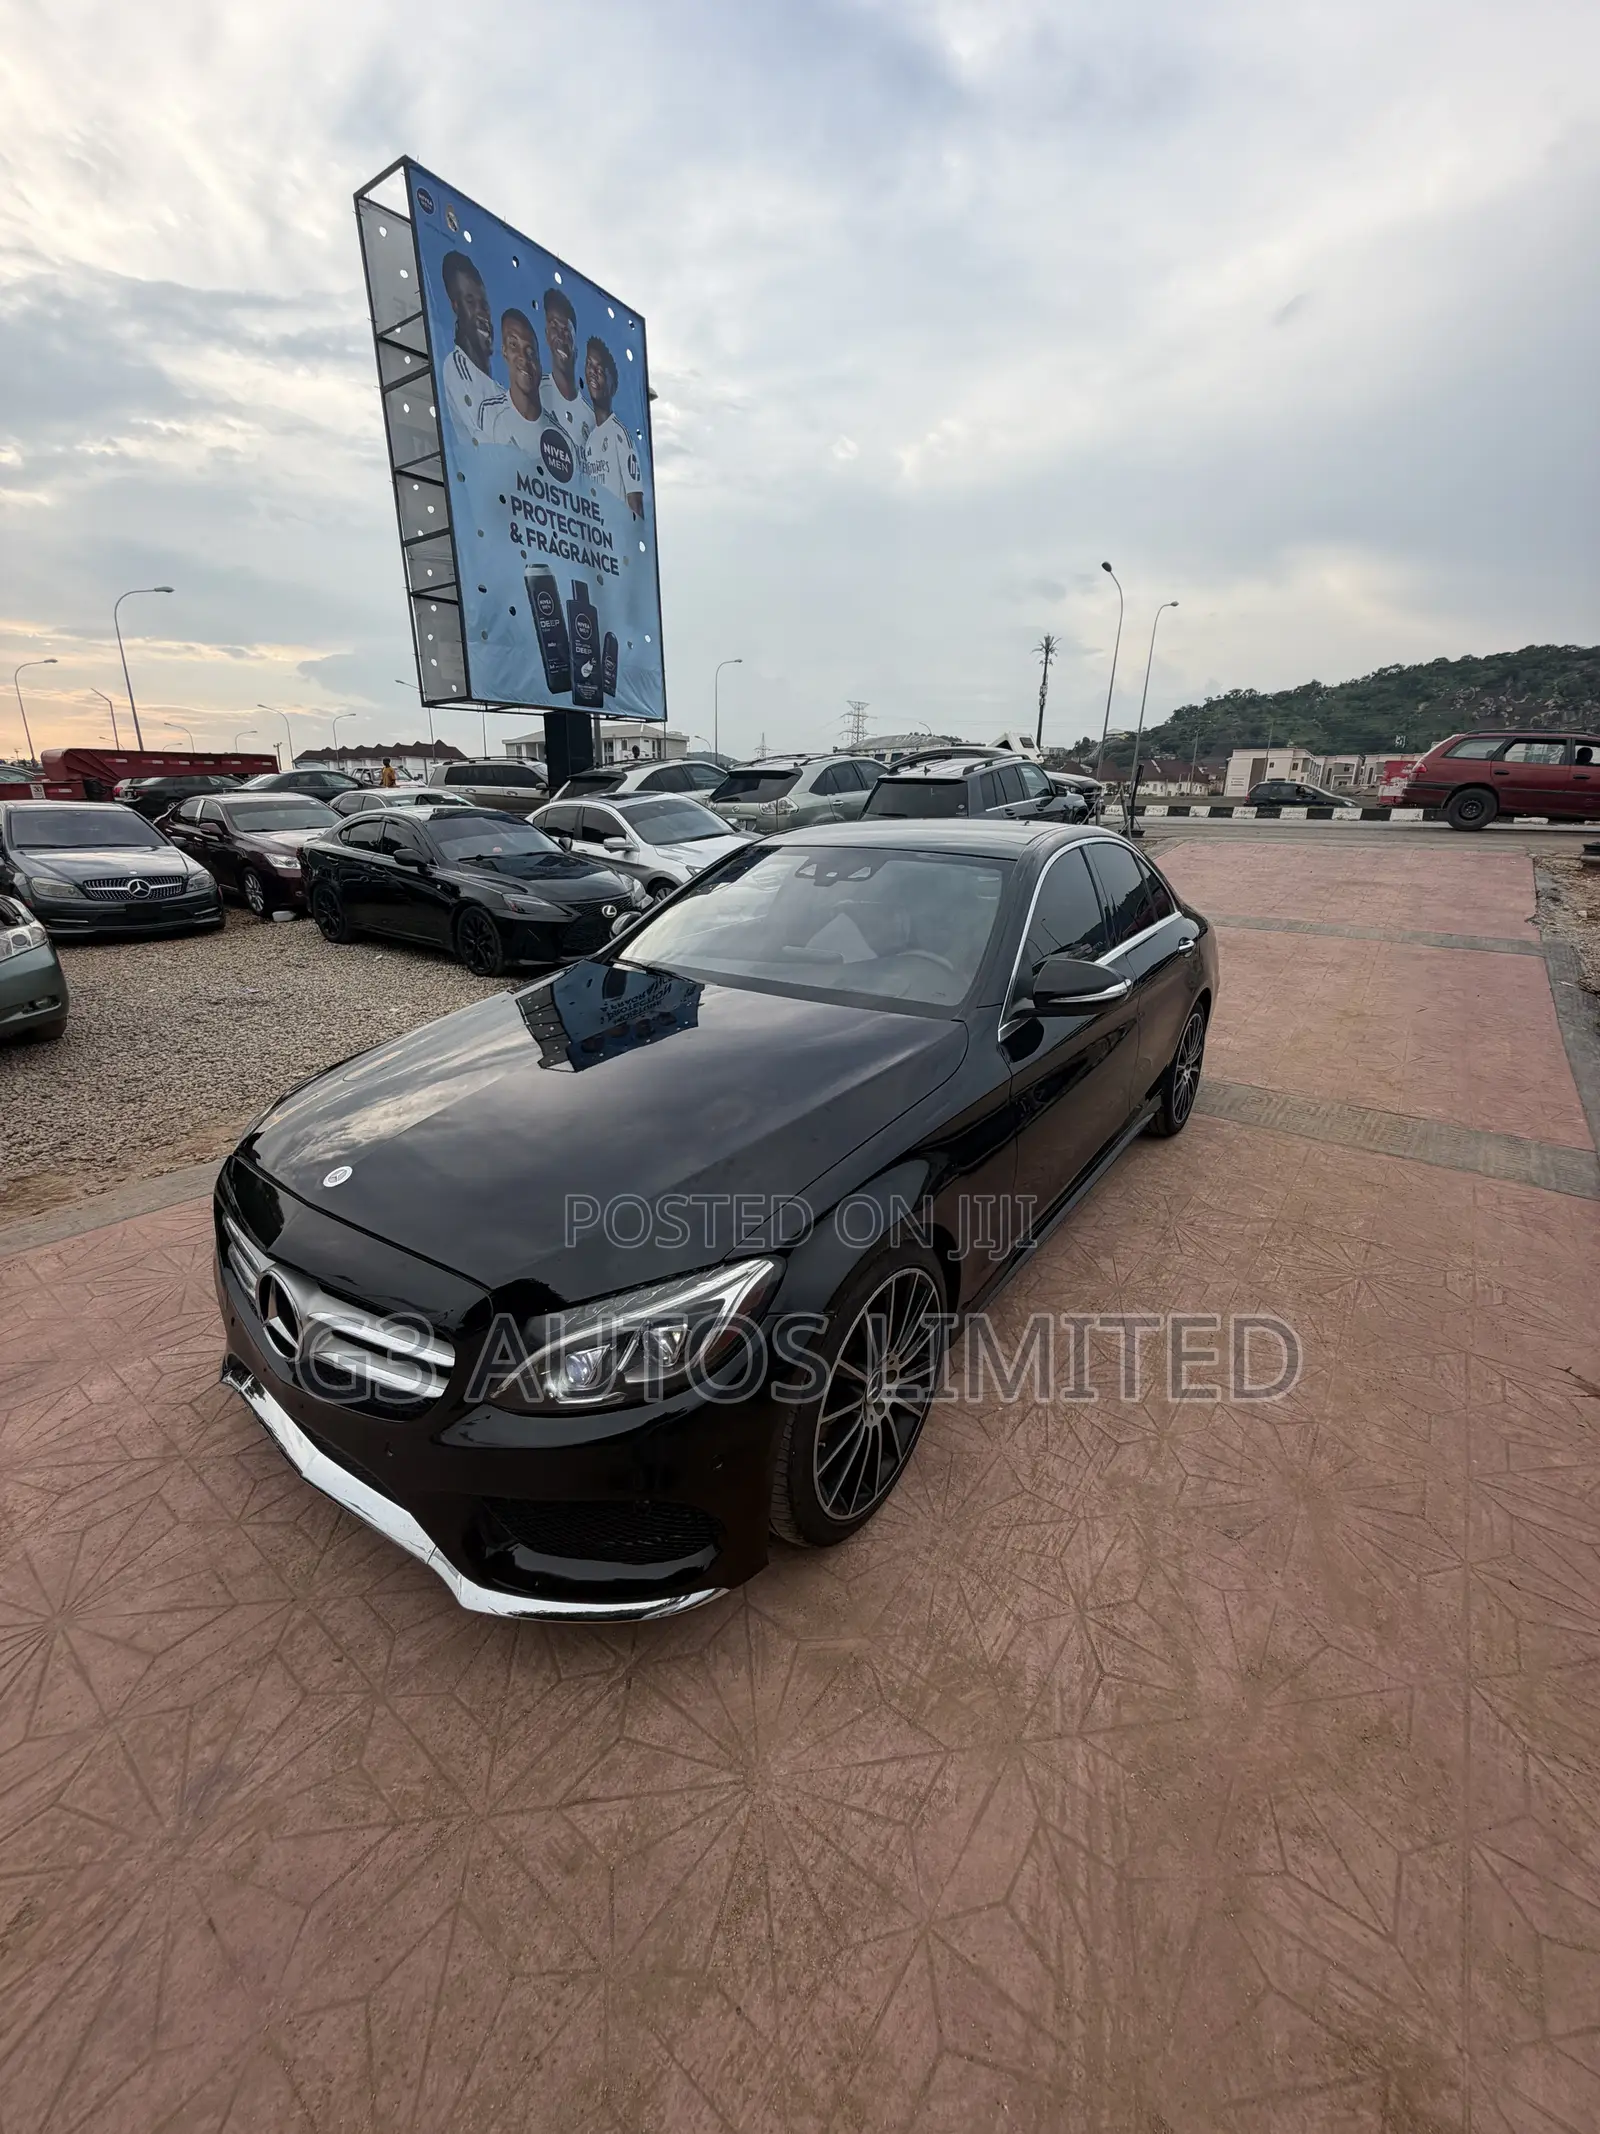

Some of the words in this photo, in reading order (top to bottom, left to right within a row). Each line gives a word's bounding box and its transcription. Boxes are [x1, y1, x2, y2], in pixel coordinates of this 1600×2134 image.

[543, 442, 571, 464] NIVEA
[548, 456, 569, 473] MEN
[516, 470, 604, 526] MOISTURE,
[510, 495, 613, 551] PROTECTION
[510, 521, 524, 545] &
[525, 527, 620, 576] FRAGRANCE
[575, 646, 592, 655] DEEP
